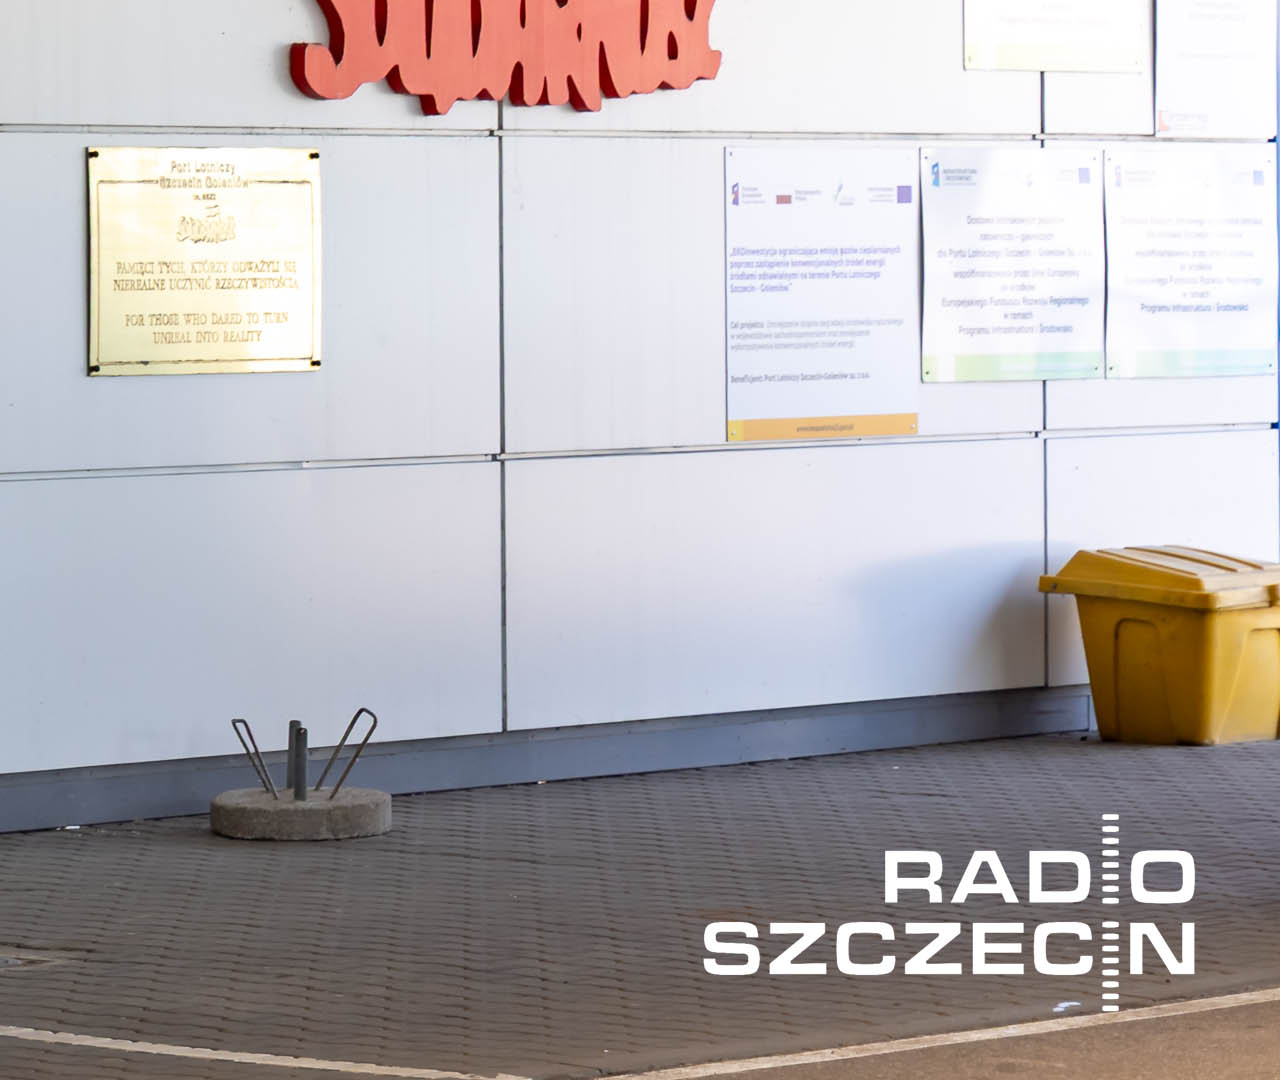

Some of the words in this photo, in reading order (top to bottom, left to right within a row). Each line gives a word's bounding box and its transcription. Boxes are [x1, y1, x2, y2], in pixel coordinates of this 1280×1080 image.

[125, 314, 144, 326] FOR
[148, 313, 180, 326] THOSE
[184, 313, 207, 325] WHO
[211, 312, 242, 325] DARED
[247, 312, 260, 324] TO
[153, 332, 192, 344] UNREAL
[195, 331, 219, 343] INTO
[223, 330, 262, 343] REALITY
